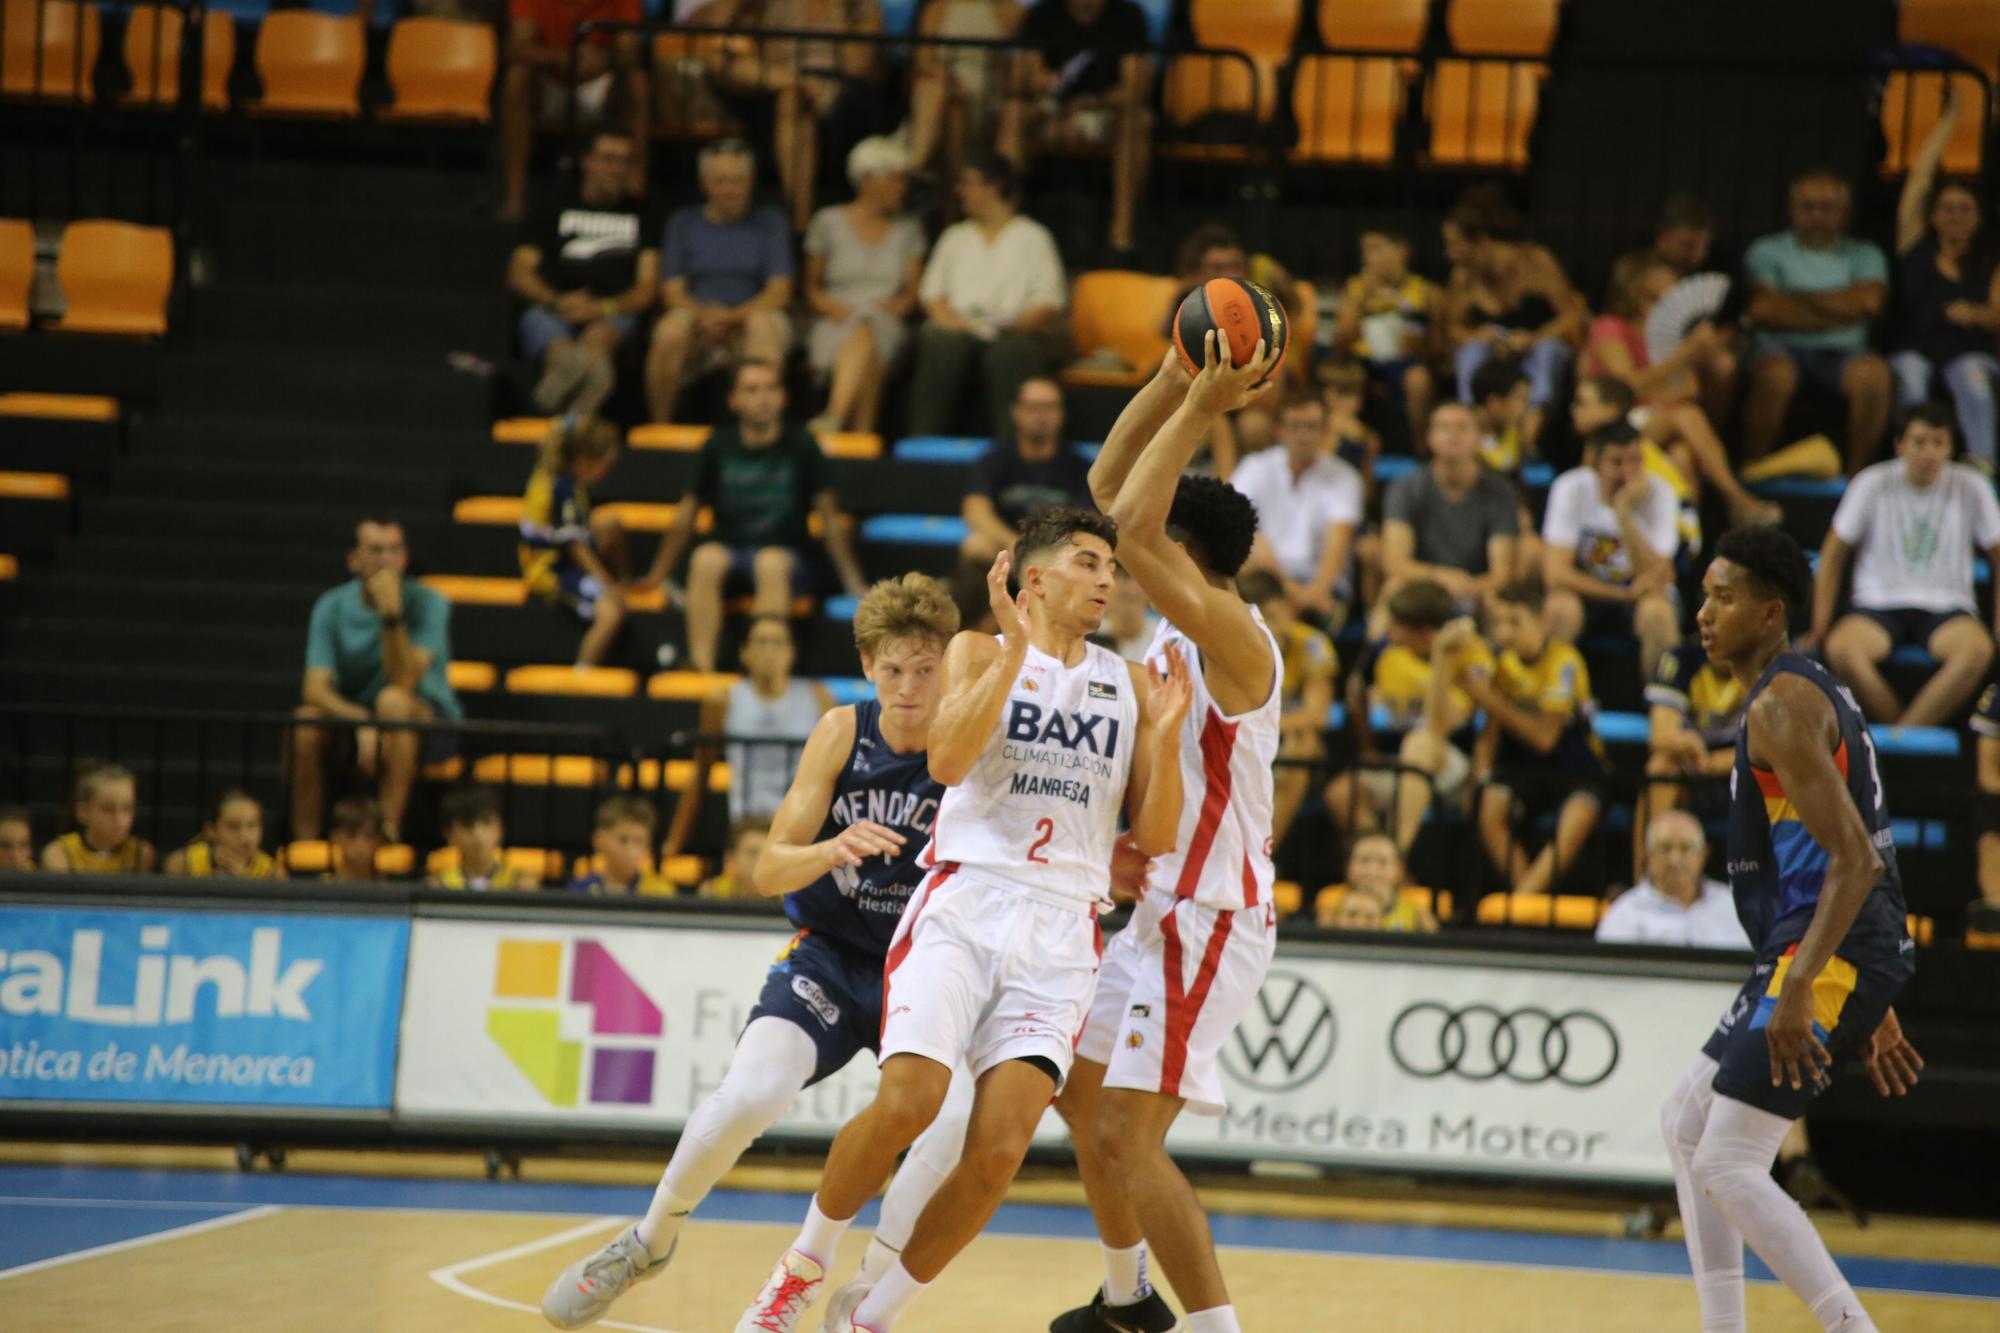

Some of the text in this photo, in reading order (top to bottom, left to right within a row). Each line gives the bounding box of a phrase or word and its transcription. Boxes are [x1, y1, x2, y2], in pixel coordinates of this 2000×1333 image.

[1006, 700, 1119, 759] BAXI
[832, 788, 938, 835] MENORC
[1010, 772, 1090, 808] MANRESA
[1027, 817, 1054, 865] 2
[0, 925, 323, 1026] aLink
[87, 1041, 138, 1082] de
[145, 1044, 316, 1087] Menorca
[1219, 1104, 1607, 1164] Medea Motor
